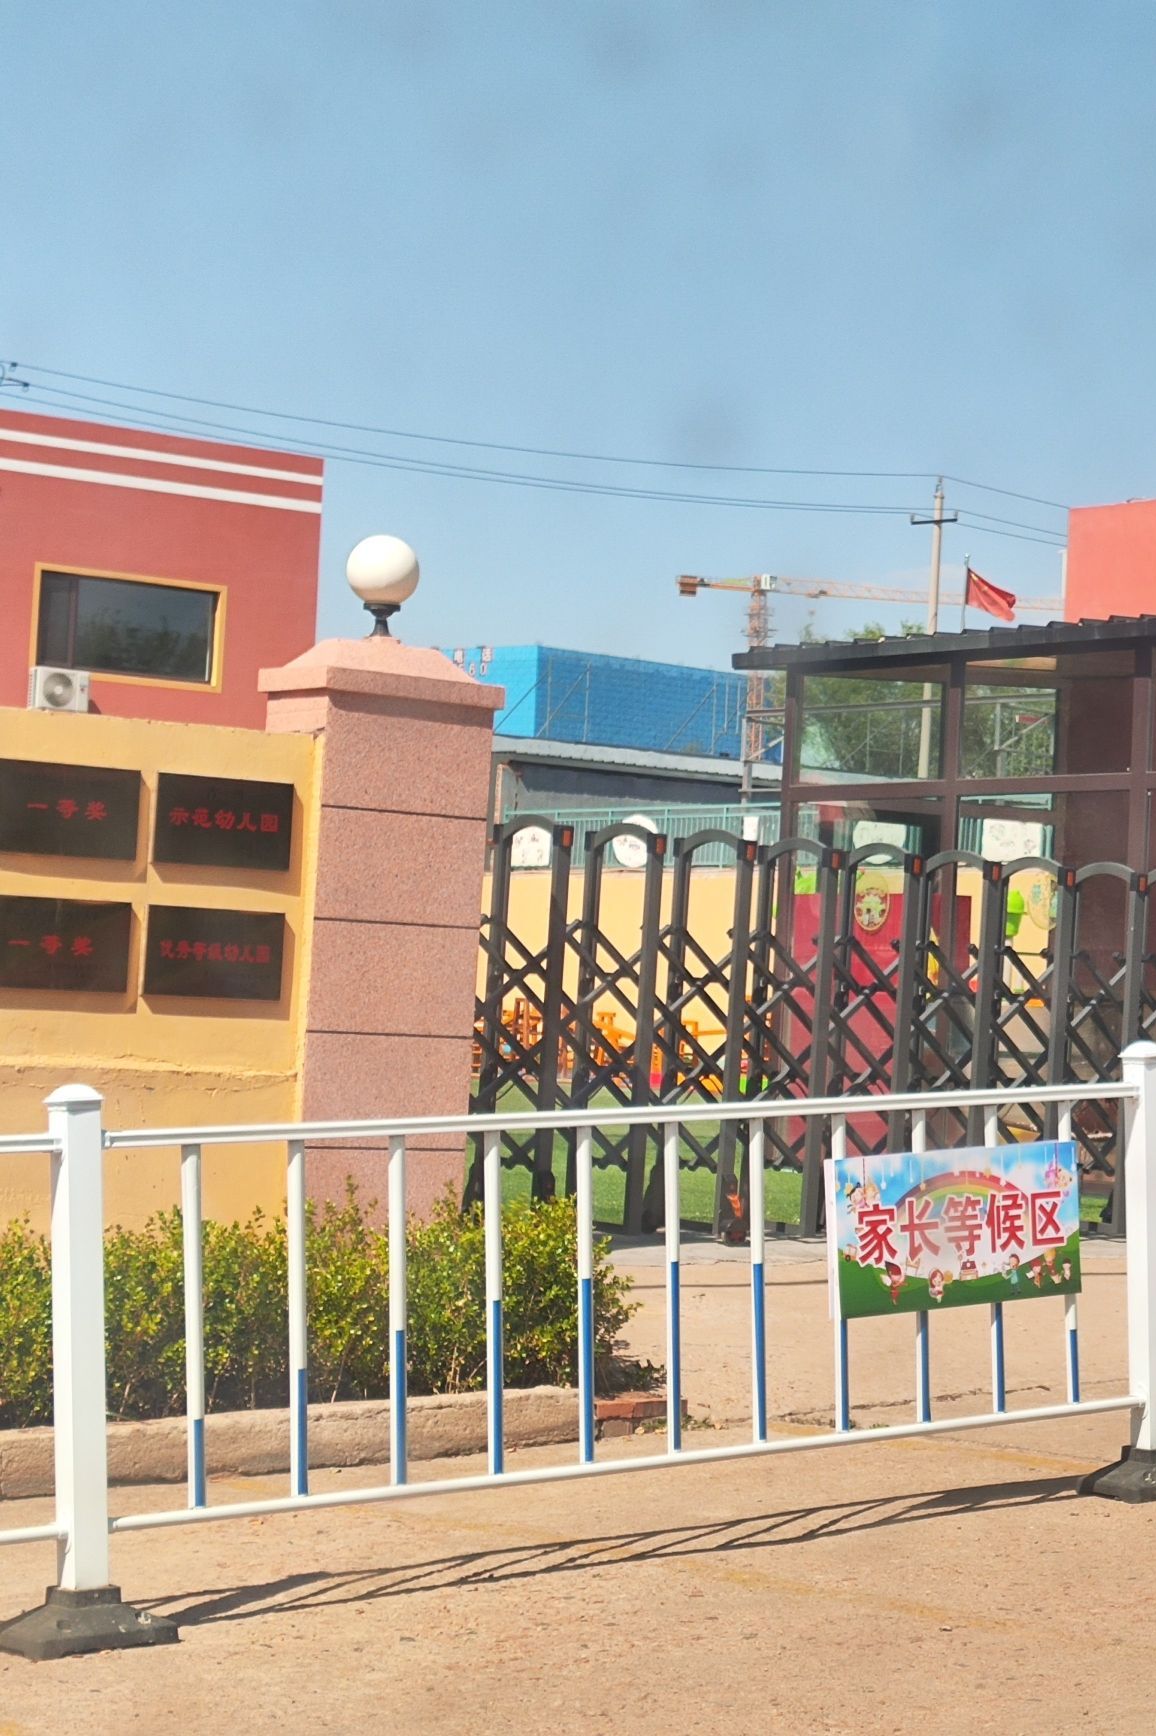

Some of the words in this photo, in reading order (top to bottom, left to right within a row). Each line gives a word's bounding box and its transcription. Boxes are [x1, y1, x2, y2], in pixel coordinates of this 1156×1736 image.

[27, 799, 107, 821] 一等奖
[169, 807, 279, 833] 示范幼儿园
[8, 934, 94, 957] 一等奖
[857, 1190, 1065, 1265] 家长等候区
